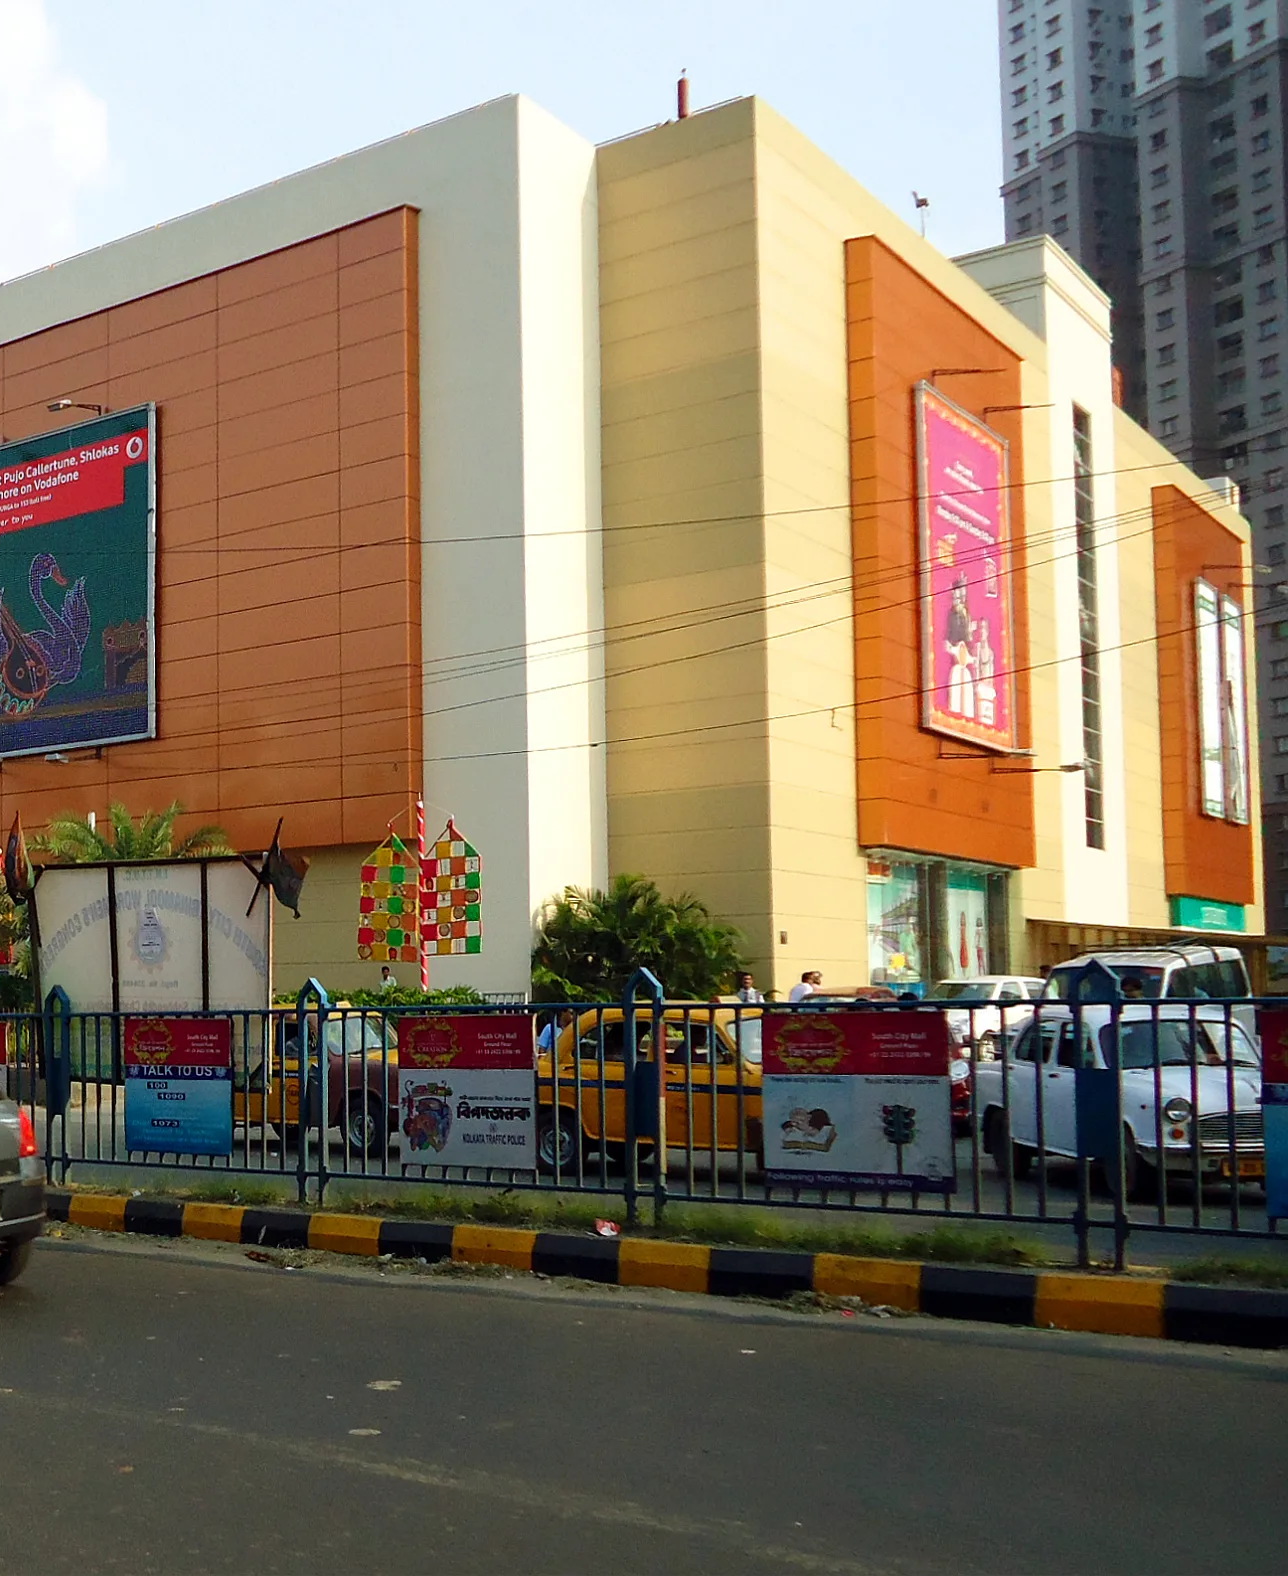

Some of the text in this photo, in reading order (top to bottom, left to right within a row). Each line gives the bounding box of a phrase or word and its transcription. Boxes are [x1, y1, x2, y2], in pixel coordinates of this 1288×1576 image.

[3, 470, 25, 484] Pujo
[26, 457, 78, 479] Callertune,
[79, 444, 120, 464] Shlokas
[21, 484, 32, 495] on
[34, 470, 80, 491] Vodafone
[11, 514, 20, 524] to
[21, 512, 34, 525] you
[494, 1033, 505, 1041] City
[142, 1065, 213, 1077] TALK TO US
[462, 1133, 526, 1146] KOLKATA TRAFFIC POLICE
[768, 1171, 815, 1183] Following
[817, 1173, 846, 1183] traffic
[849, 1176, 875, 1184] rules
[887, 1178, 914, 1188] easy
